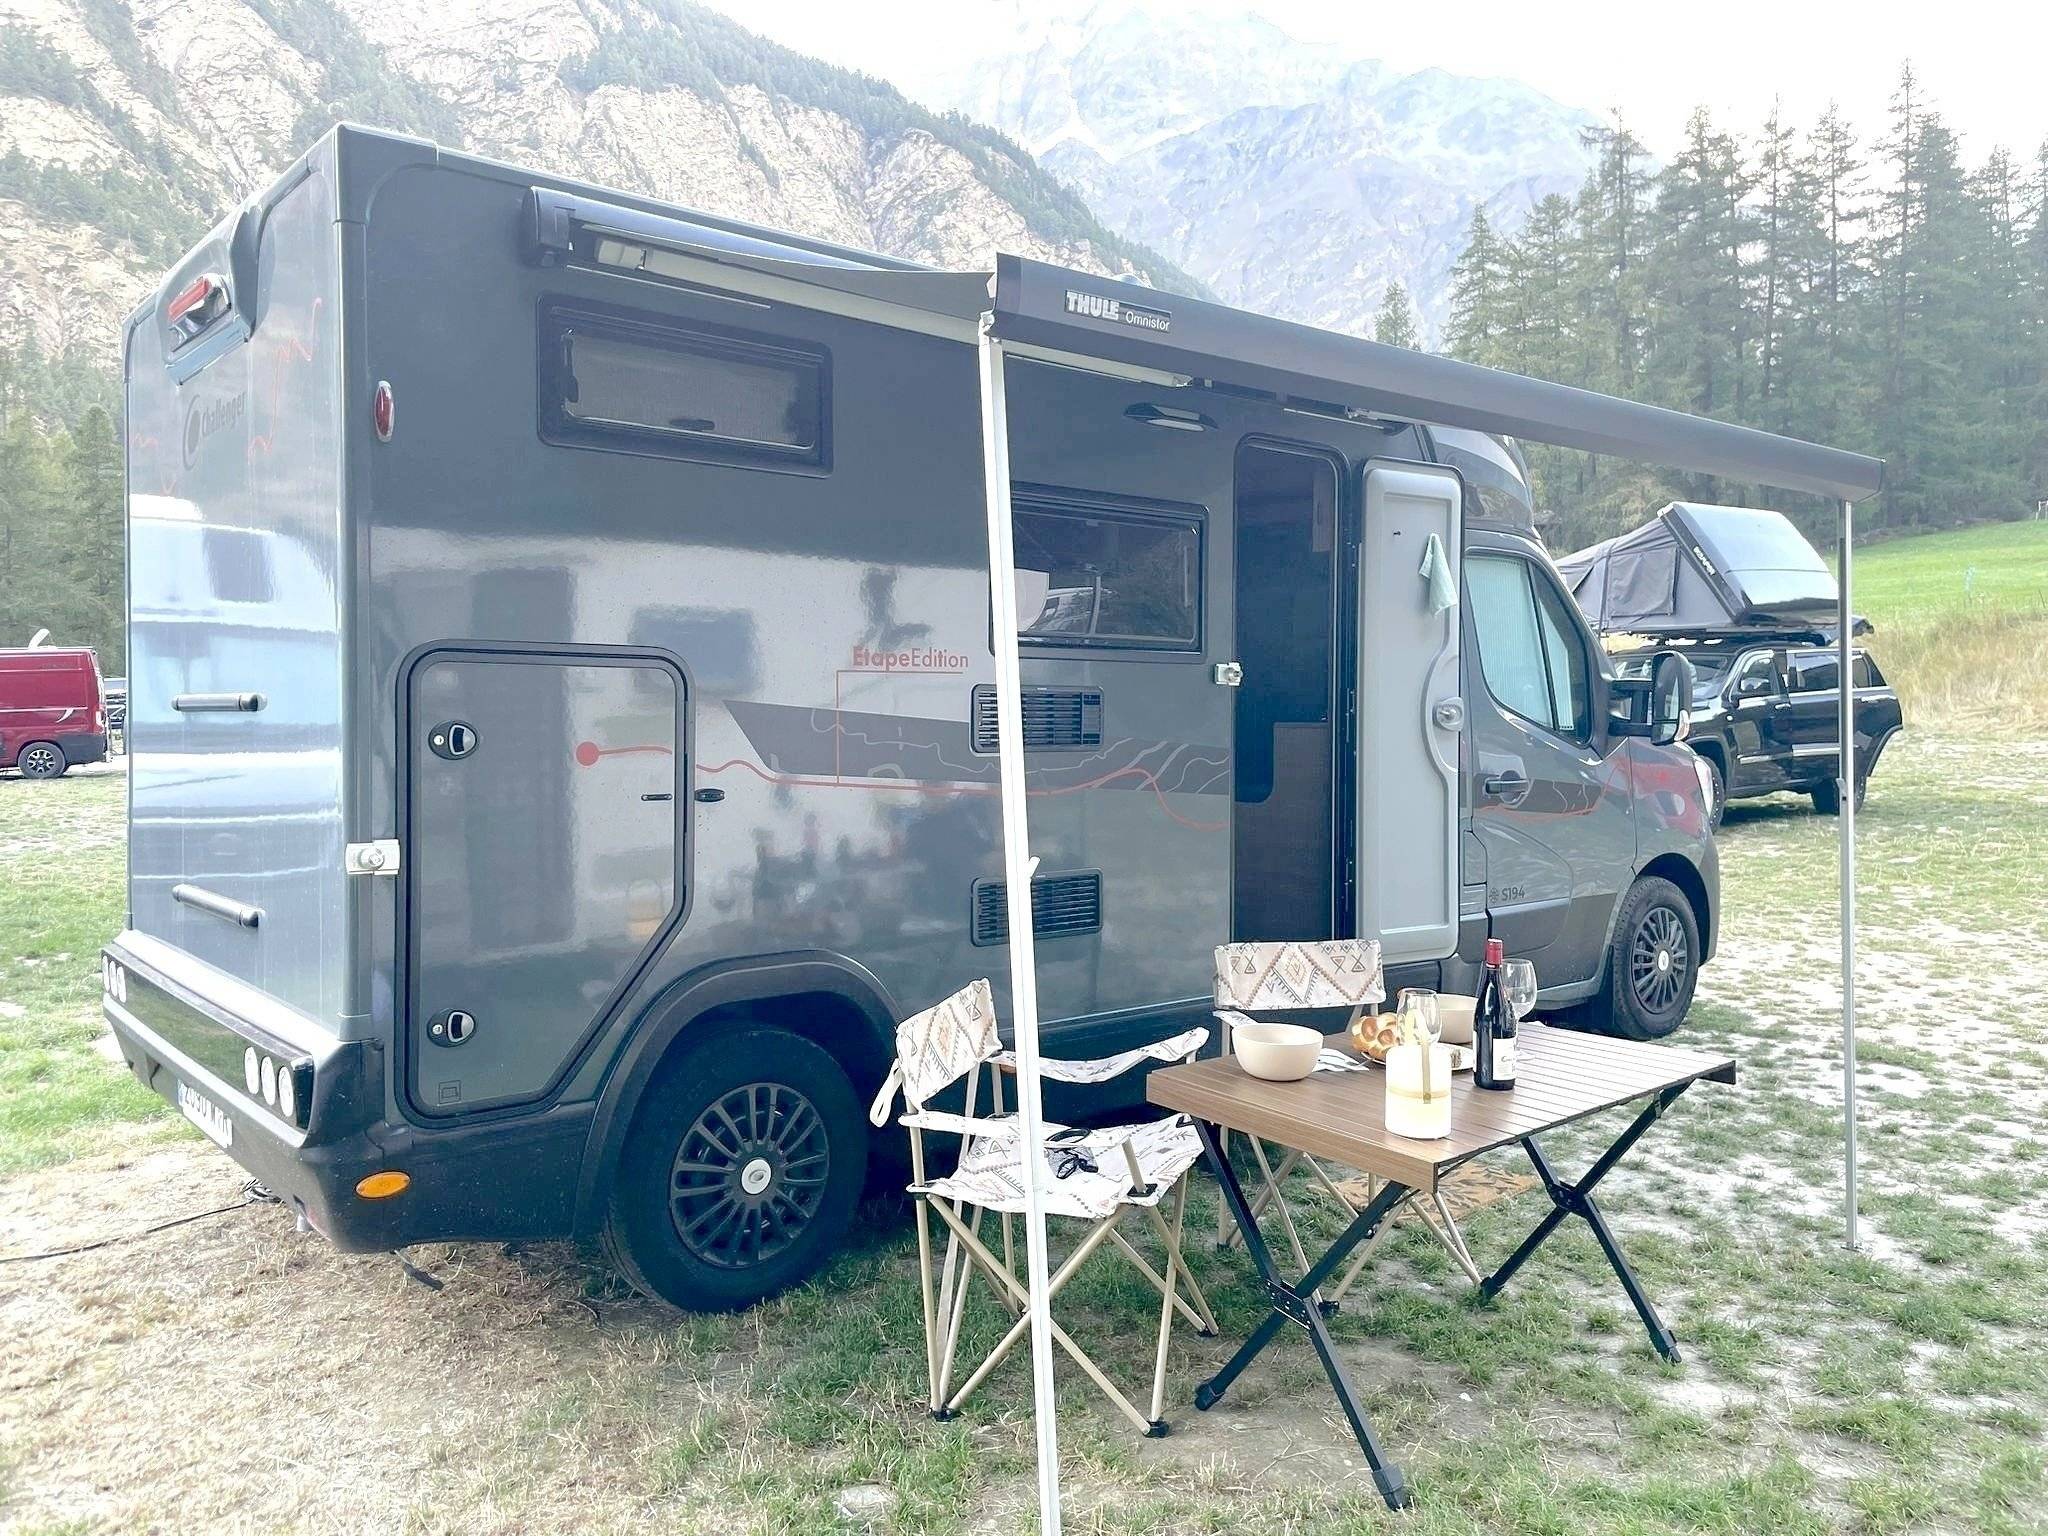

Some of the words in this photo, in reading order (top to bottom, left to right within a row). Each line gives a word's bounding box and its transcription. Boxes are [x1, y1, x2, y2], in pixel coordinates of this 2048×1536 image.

[1066, 291, 1120, 321] THULE
[1125, 310, 1171, 331] Omnistor
[1501, 885, 1526, 901] S194
